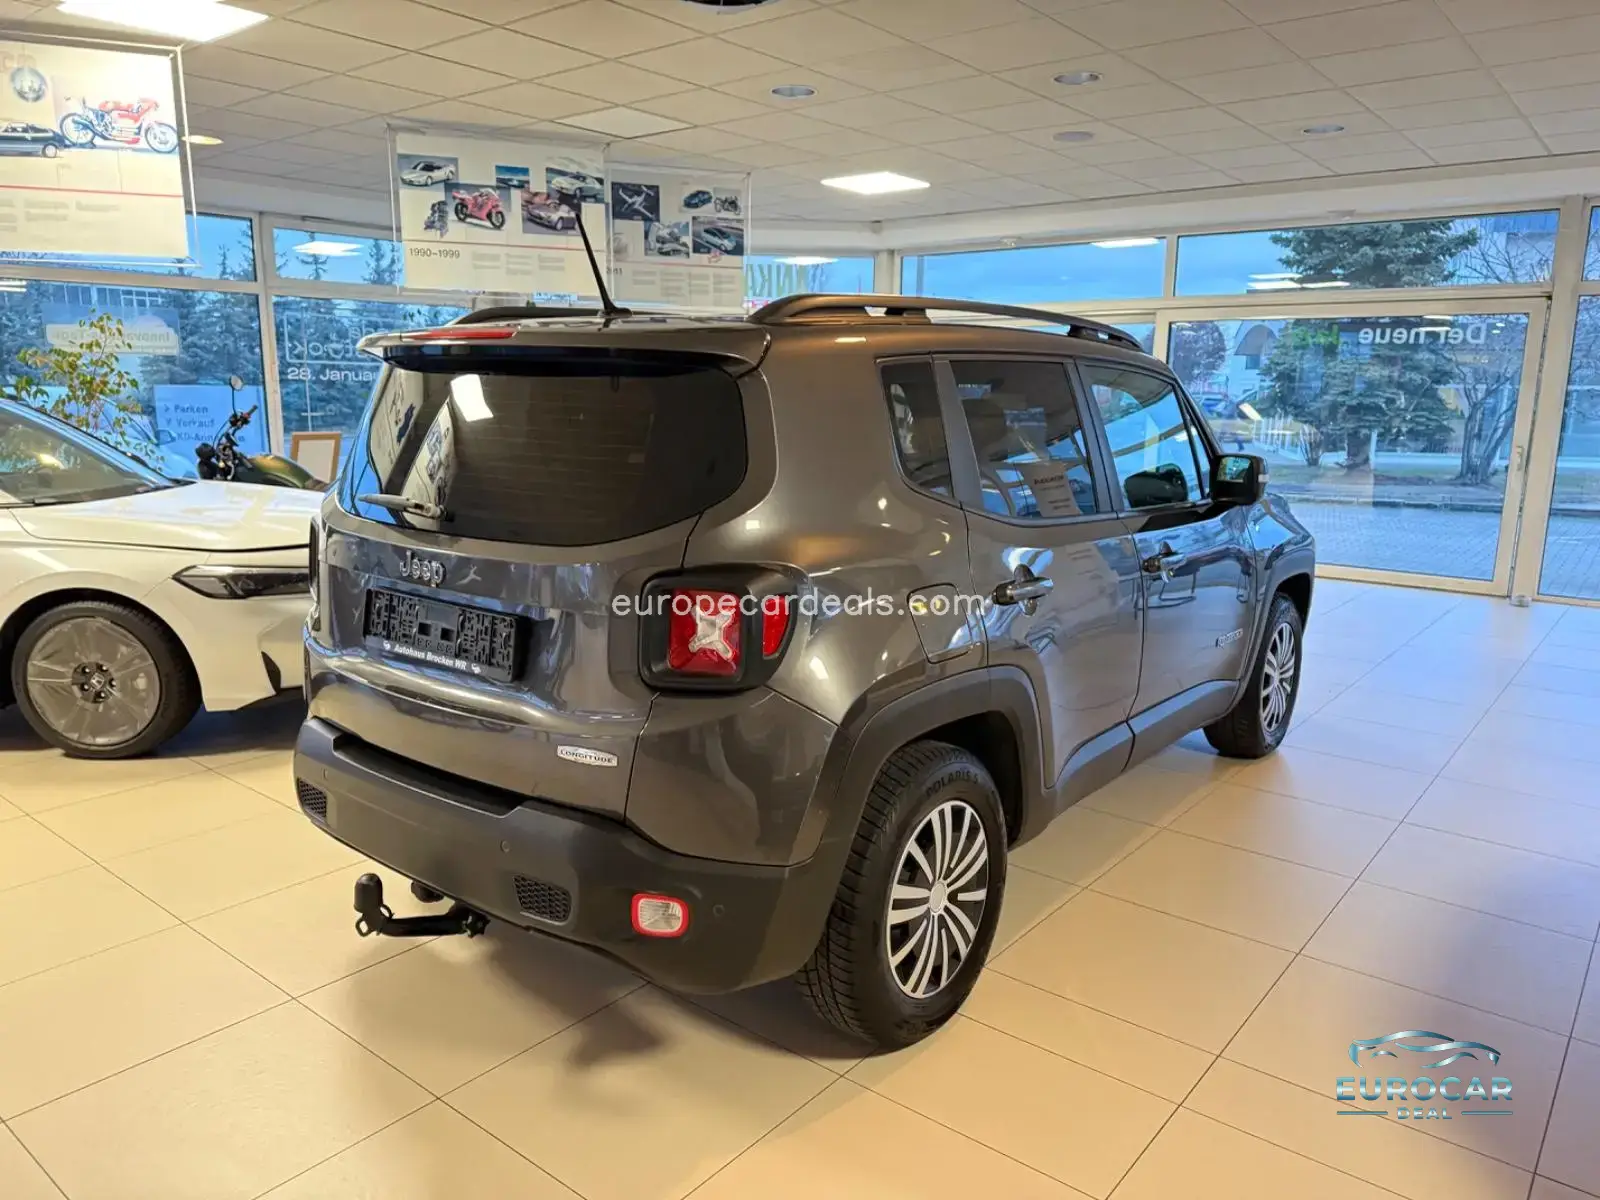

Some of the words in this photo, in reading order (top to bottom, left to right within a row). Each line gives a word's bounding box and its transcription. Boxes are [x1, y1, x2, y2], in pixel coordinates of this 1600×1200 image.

[174, 404, 209, 414] Parken
[176, 418, 215, 428] Verkauf
[400, 550, 446, 587] Jeep
[394, 644, 425, 659] Autohaus
[426, 651, 454, 667] Brocken
[455, 659, 467, 670] WR
